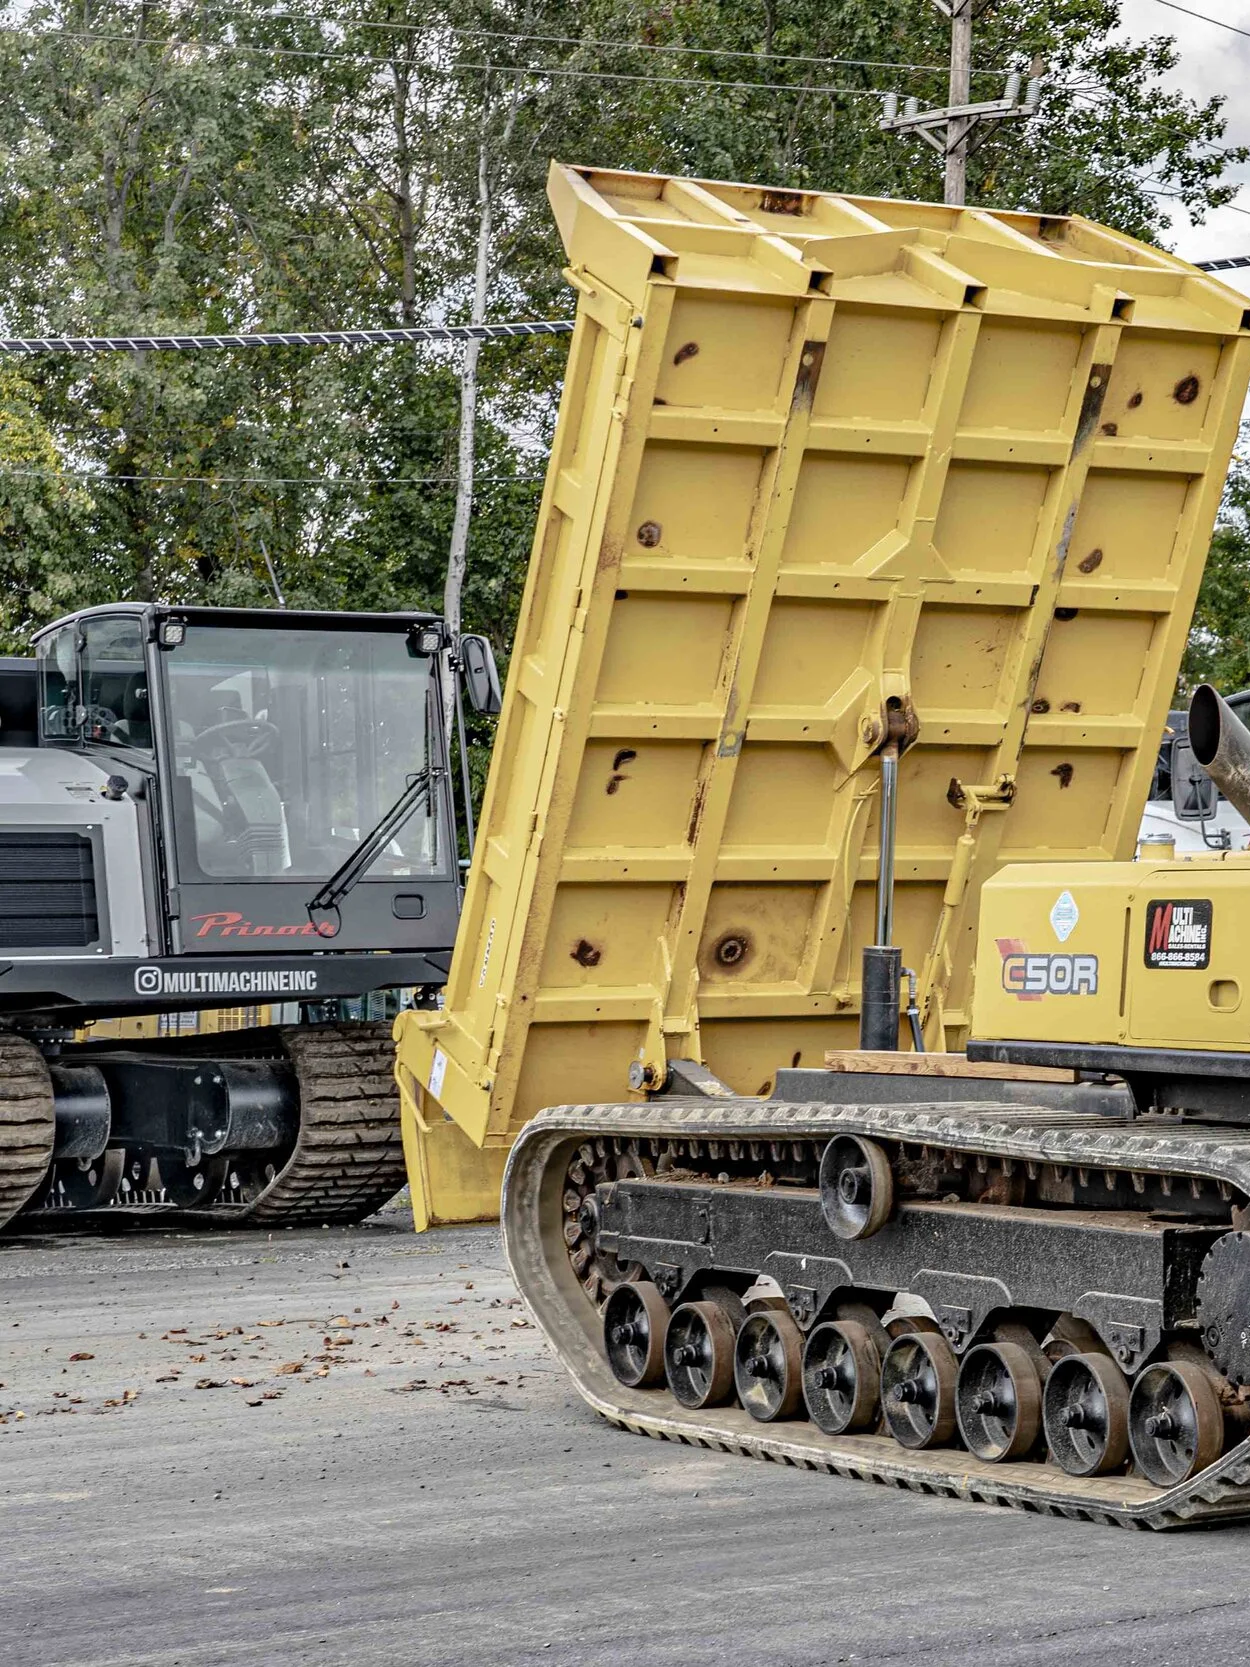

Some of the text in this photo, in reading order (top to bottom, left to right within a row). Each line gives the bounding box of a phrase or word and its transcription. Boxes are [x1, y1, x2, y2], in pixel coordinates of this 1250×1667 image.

[191, 912, 335, 937] Prinoth
[1151, 952, 1205, 962] 866-866-8584
[163, 970, 317, 993] MULTIMACHINEINC
[1003, 954, 1098, 995] C50R
